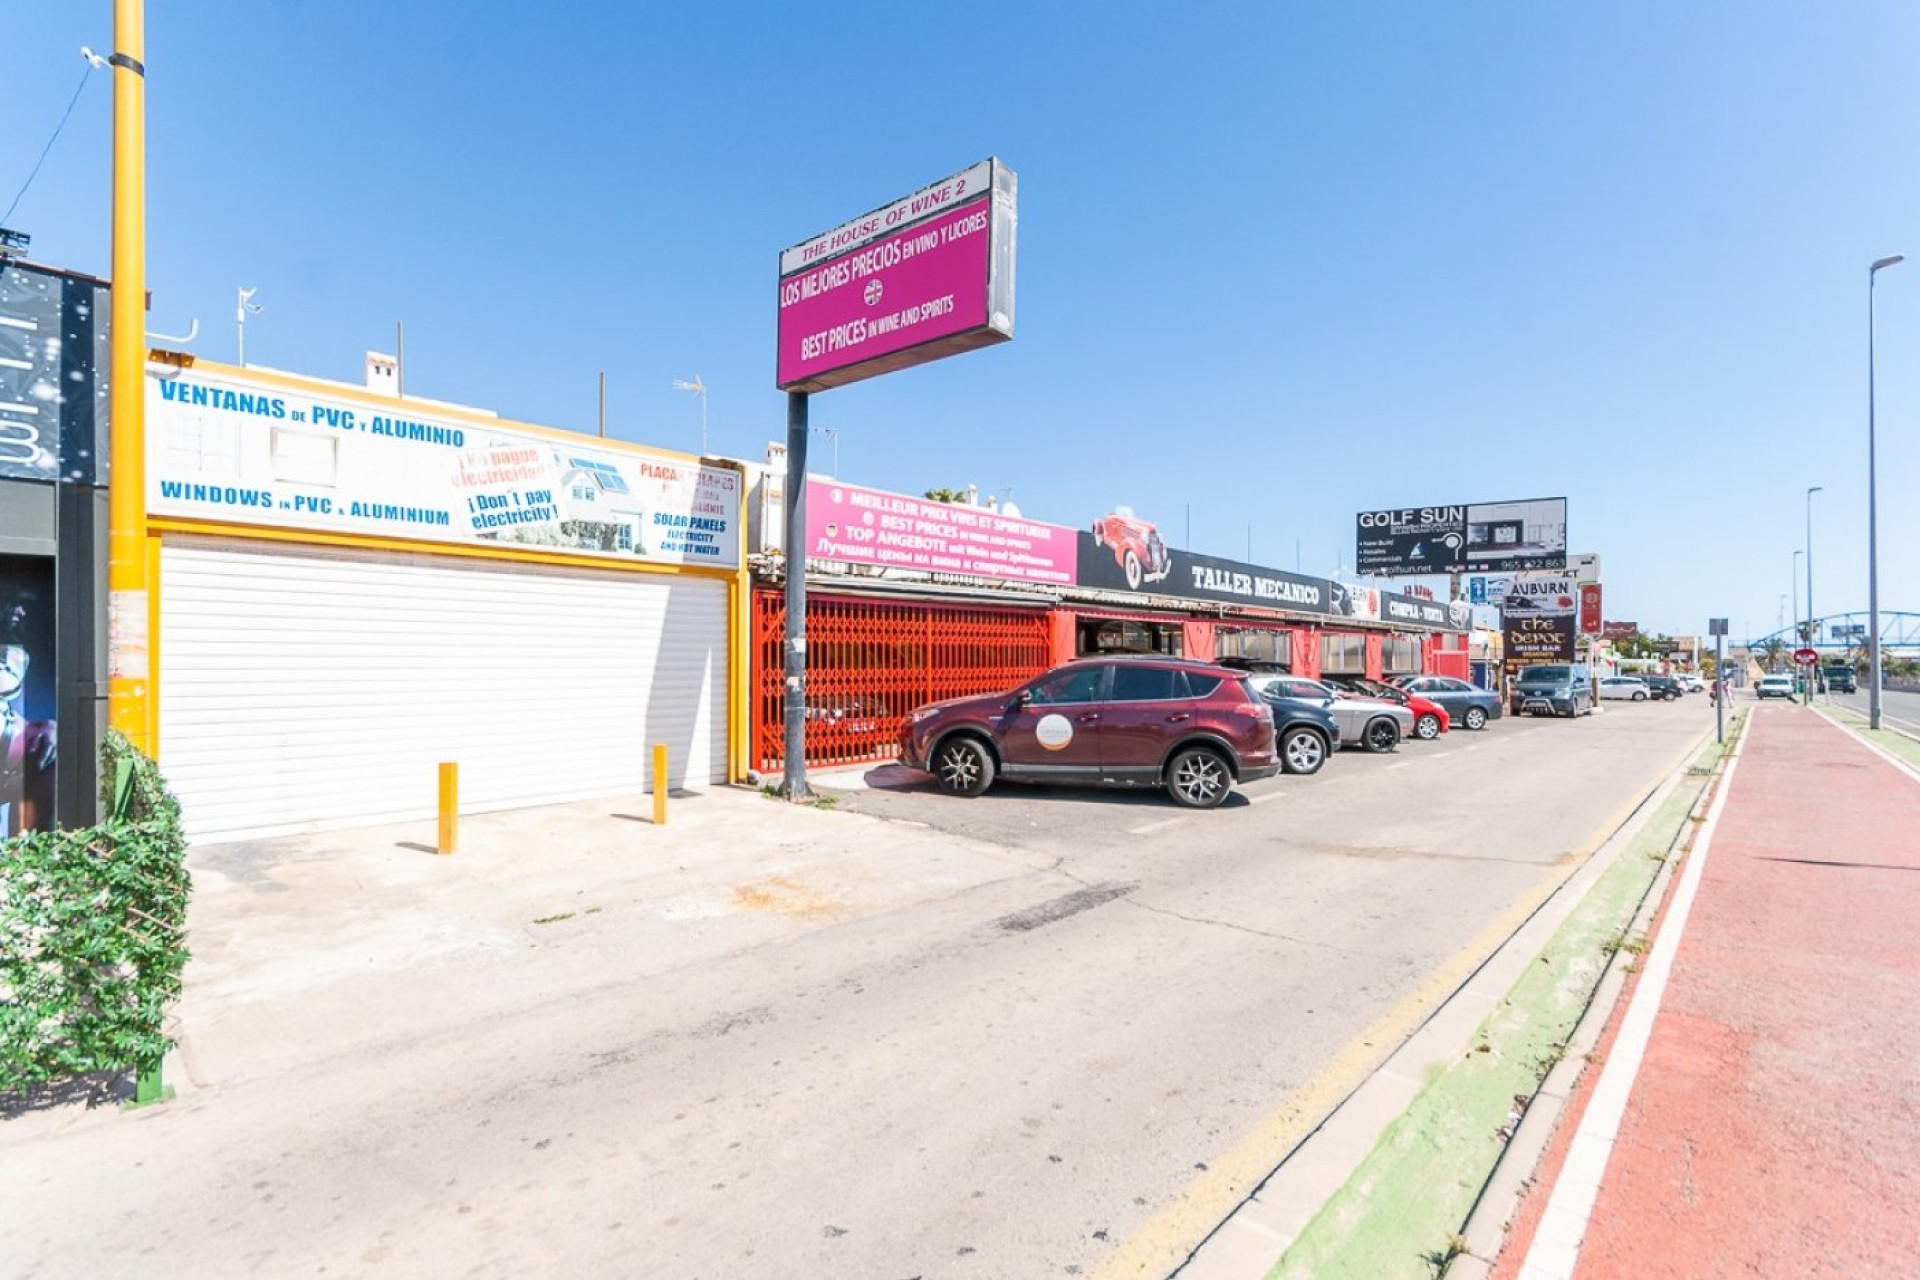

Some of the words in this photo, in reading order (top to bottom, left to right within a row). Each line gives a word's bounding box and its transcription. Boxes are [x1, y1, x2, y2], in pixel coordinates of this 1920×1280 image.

[803, 241, 826, 261] THE
[831, 219, 879, 250] HOUSE
[886, 208, 906, 227] OF
[910, 187, 951, 215] WINE
[955, 179, 966, 195] 2
[781, 278, 800, 308] LOS
[801, 261, 850, 300] MEJORES
[852, 239, 901, 281] PRECIOS
[903, 243, 915, 260] EN
[915, 231, 938, 256] VINO
[940, 227, 948, 245] Y
[948, 210, 987, 241] LICORES
[801, 332, 827, 361] BEST
[829, 318, 866, 352] PRICES
[868, 322, 876, 338] IN
[878, 312, 899, 336] WINE
[900, 306, 920, 328] AND
[921, 294, 954, 321] SPIRITS
[160, 378, 285, 419] VENTANAS
[291, 409, 306, 423] DE
[312, 405, 354, 431] PVC
[359, 421, 367, 432] Y
[371, 416, 465, 448] ALUMINIO
[641, 463, 683, 482] PLACA
[160, 480, 272, 509] WINDOWS
[294, 495, 332, 514] PVC
[351, 501, 450, 525] ALUMINIUM
[525, 489, 552, 506] pay
[850, 491, 919, 516] MEILLEUR
[921, 505, 949, 521] PRIX
[654, 512, 688, 527] SOLAR
[690, 517, 727, 533] PANELS
[881, 514, 914, 531] BEST
[916, 521, 957, 539] PRICES
[1360, 510, 1414, 527] GOLF
[1420, 506, 1463, 524] SUN
[845, 525, 875, 542] TOP
[877, 531, 947, 553] ANGEBOTE
[1192, 565, 1253, 595] TALLER
[1254, 576, 1319, 605] MECANICO
[1511, 582, 1568, 595] AUBURN
